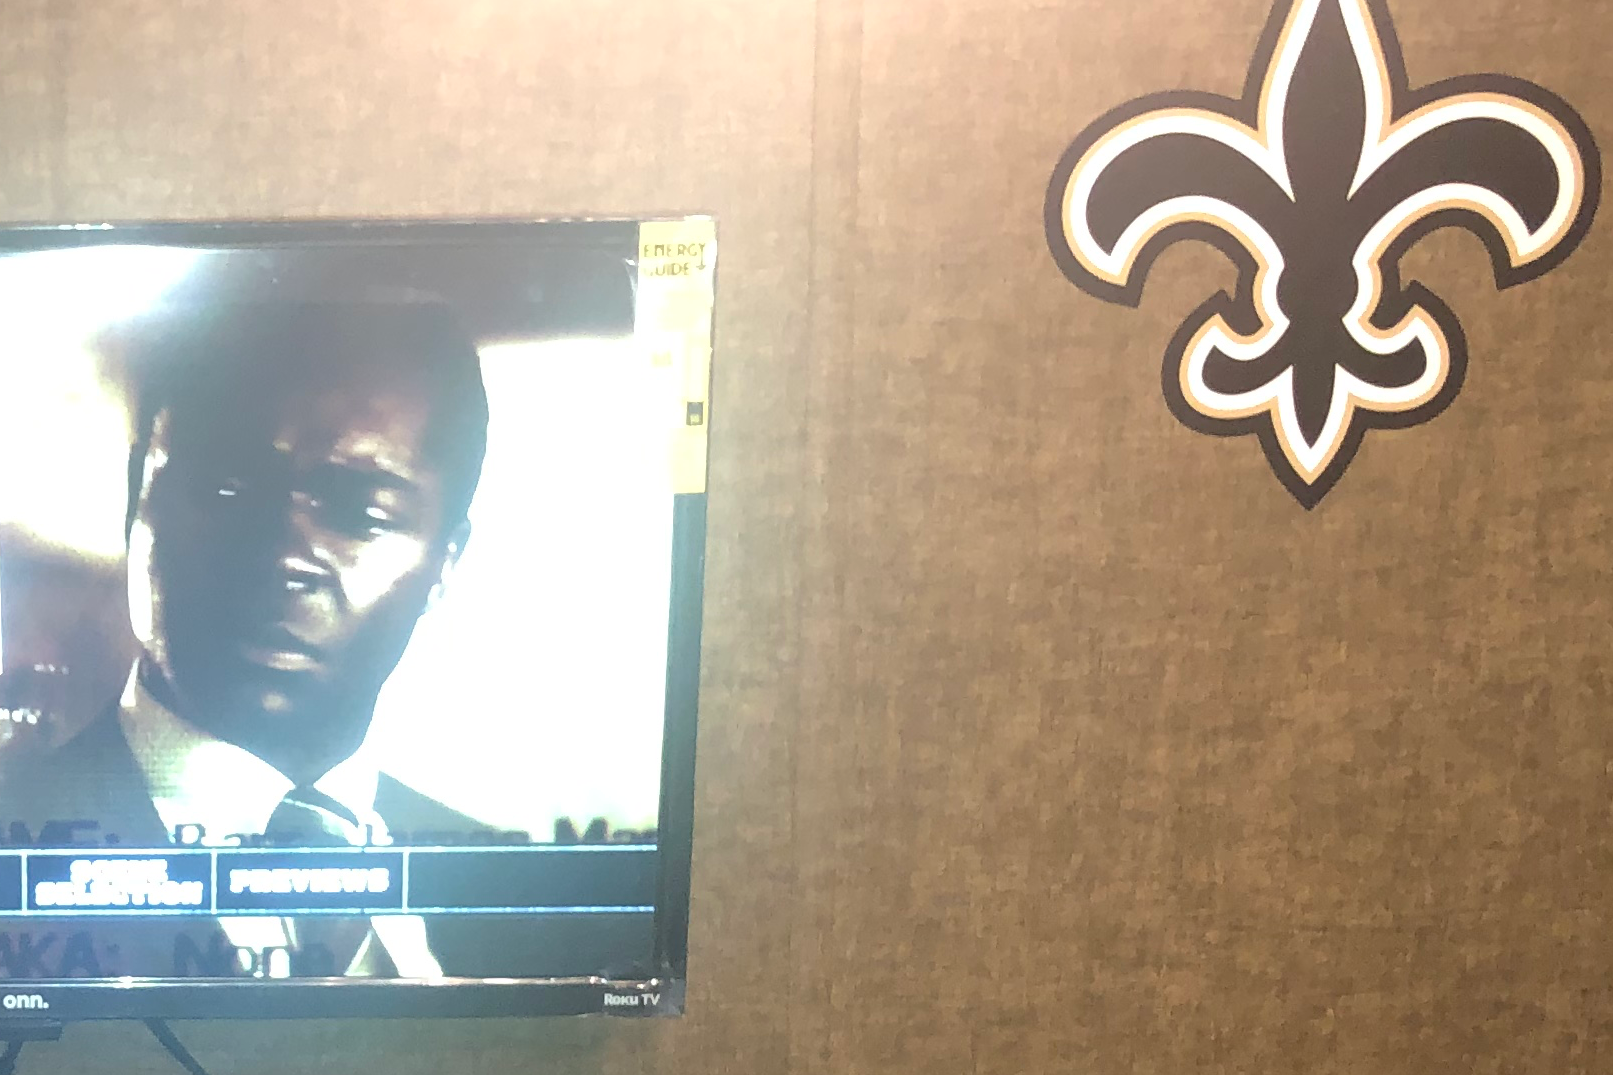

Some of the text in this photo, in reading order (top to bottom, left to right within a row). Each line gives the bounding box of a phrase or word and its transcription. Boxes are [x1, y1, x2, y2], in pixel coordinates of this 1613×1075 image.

[644, 263, 689, 277] UIDE
[229, 868, 389, 893] PREVIEWS
[2, 994, 50, 1009] onn.
[603, 993, 661, 1006] Roku TV
